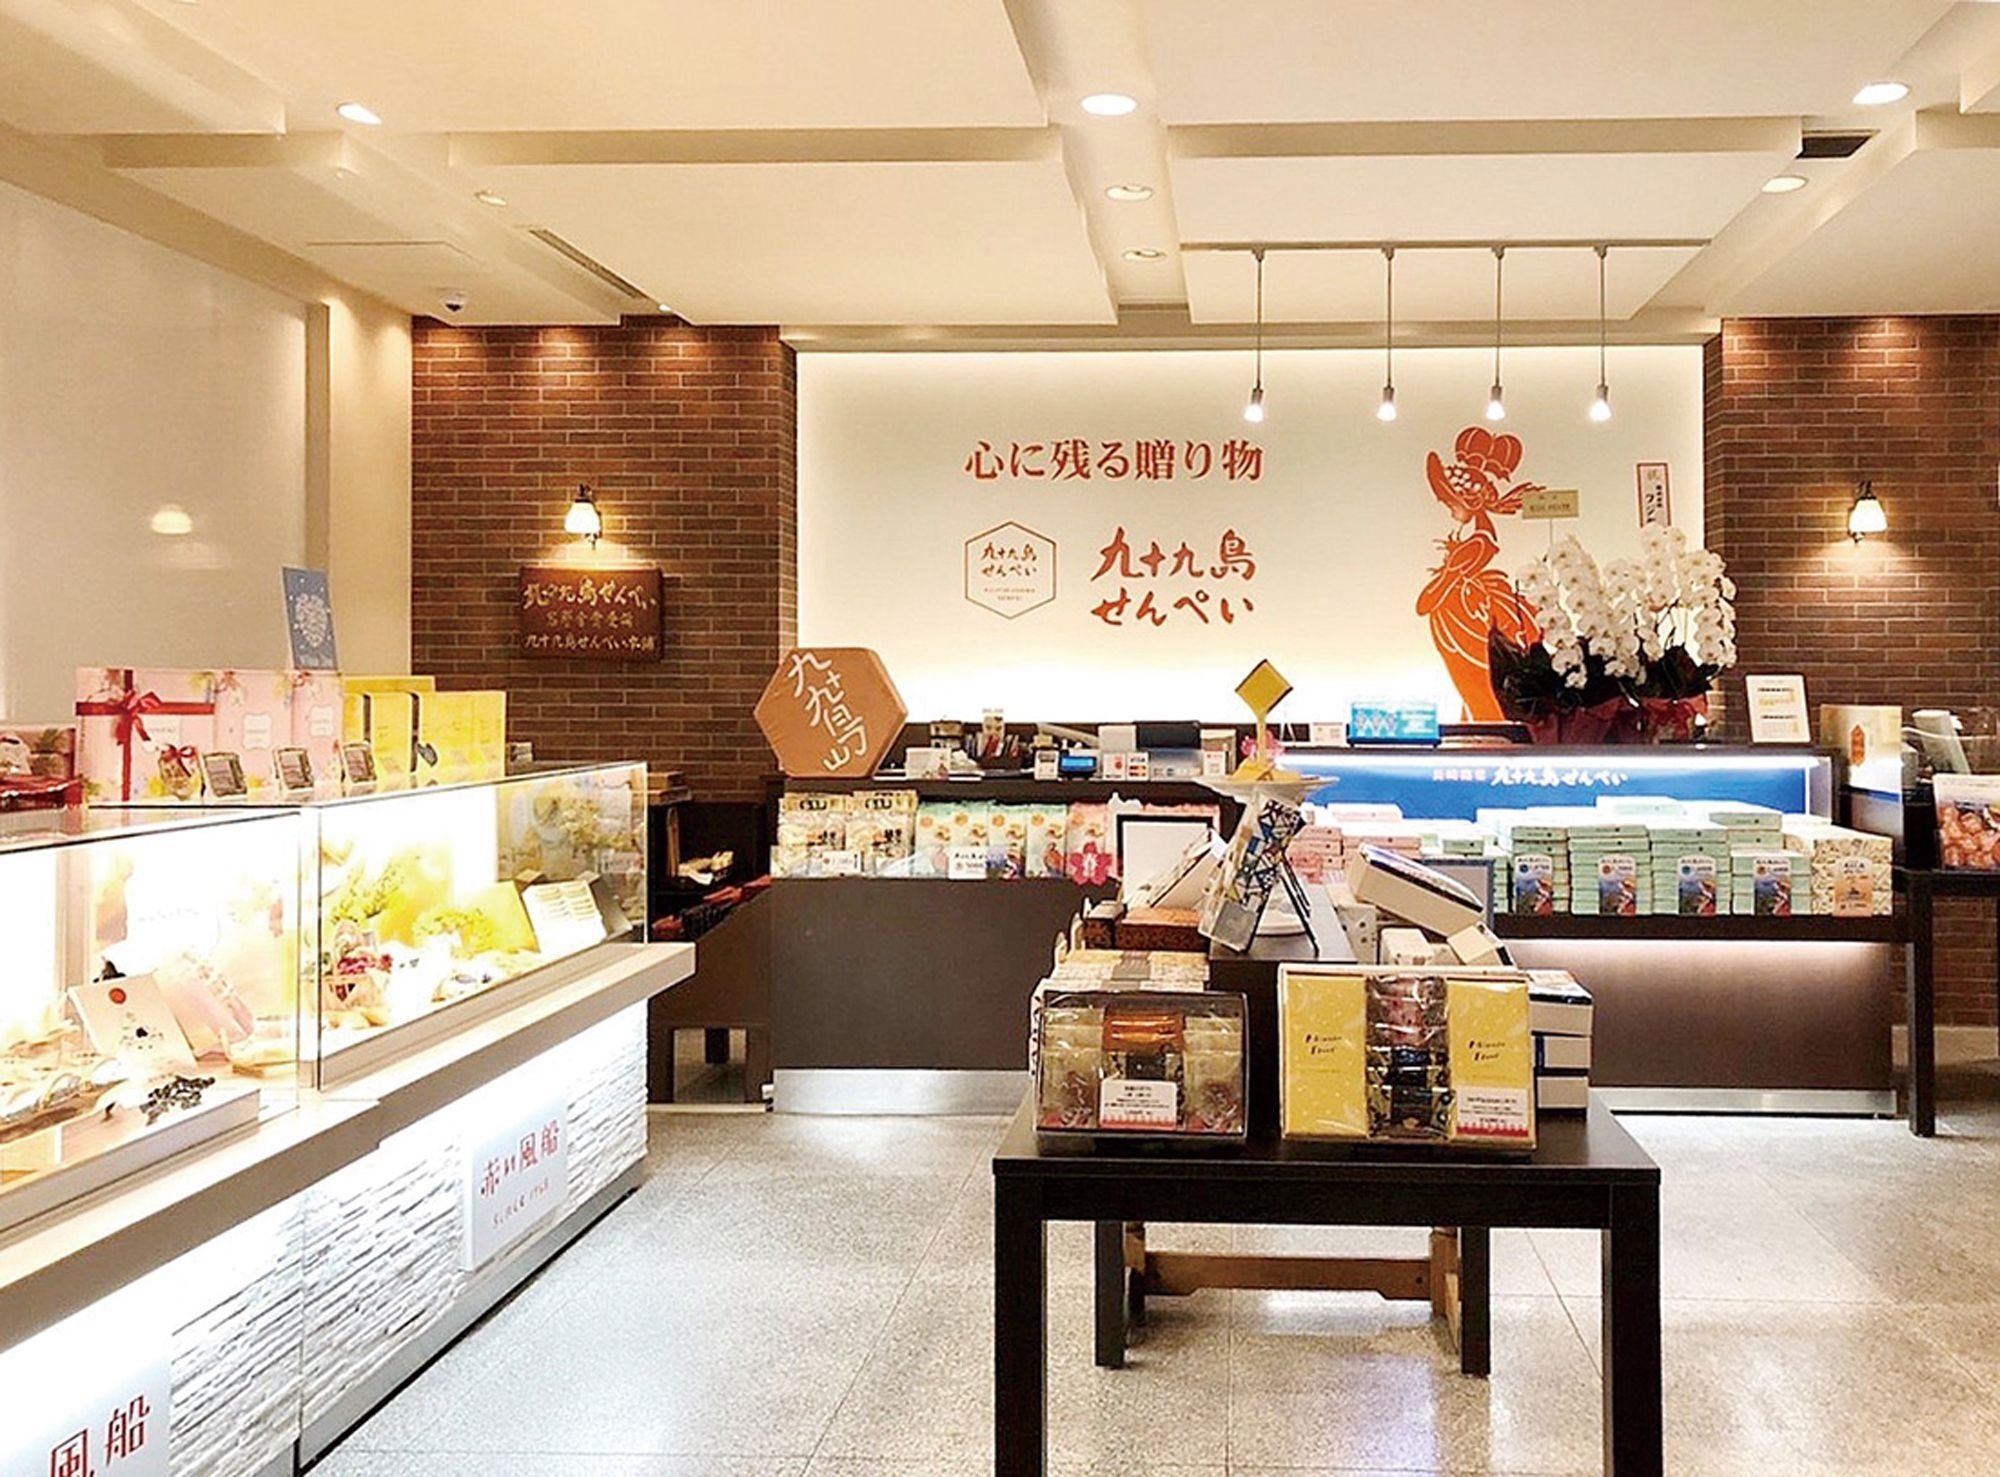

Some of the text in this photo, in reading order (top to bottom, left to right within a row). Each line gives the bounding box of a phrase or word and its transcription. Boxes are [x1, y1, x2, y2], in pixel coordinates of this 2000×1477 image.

[965, 440, 1263, 481] 心に残る贈り物
[981, 541, 1037, 562] 九十九島
[1091, 526, 1256, 581] 九十九島
[1091, 587, 1254, 627] せんぺい
[480, 1119, 560, 1198] 赤い風船
